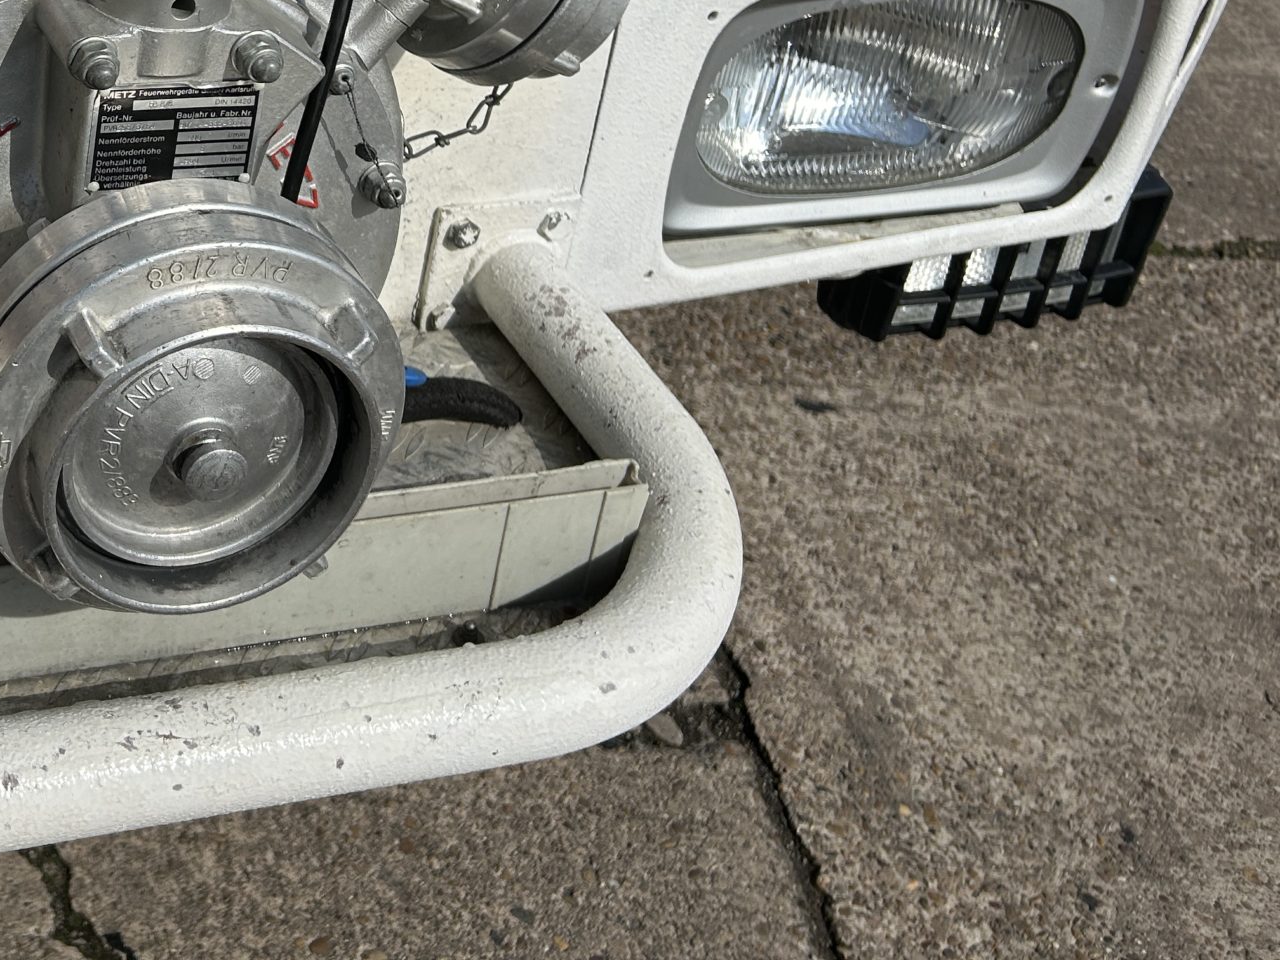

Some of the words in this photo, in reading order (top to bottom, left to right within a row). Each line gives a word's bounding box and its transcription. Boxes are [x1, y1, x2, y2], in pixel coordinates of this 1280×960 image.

[103, 103, 122, 113] Type
[176, 110, 208, 120] Baujahr
[98, 136, 165, 145] Nennförderstrom
[97, 148, 161, 157] Nennförderhöhe
[96, 158, 131, 167] Drehzahl
[95, 165, 147, 175] Nennleistung
